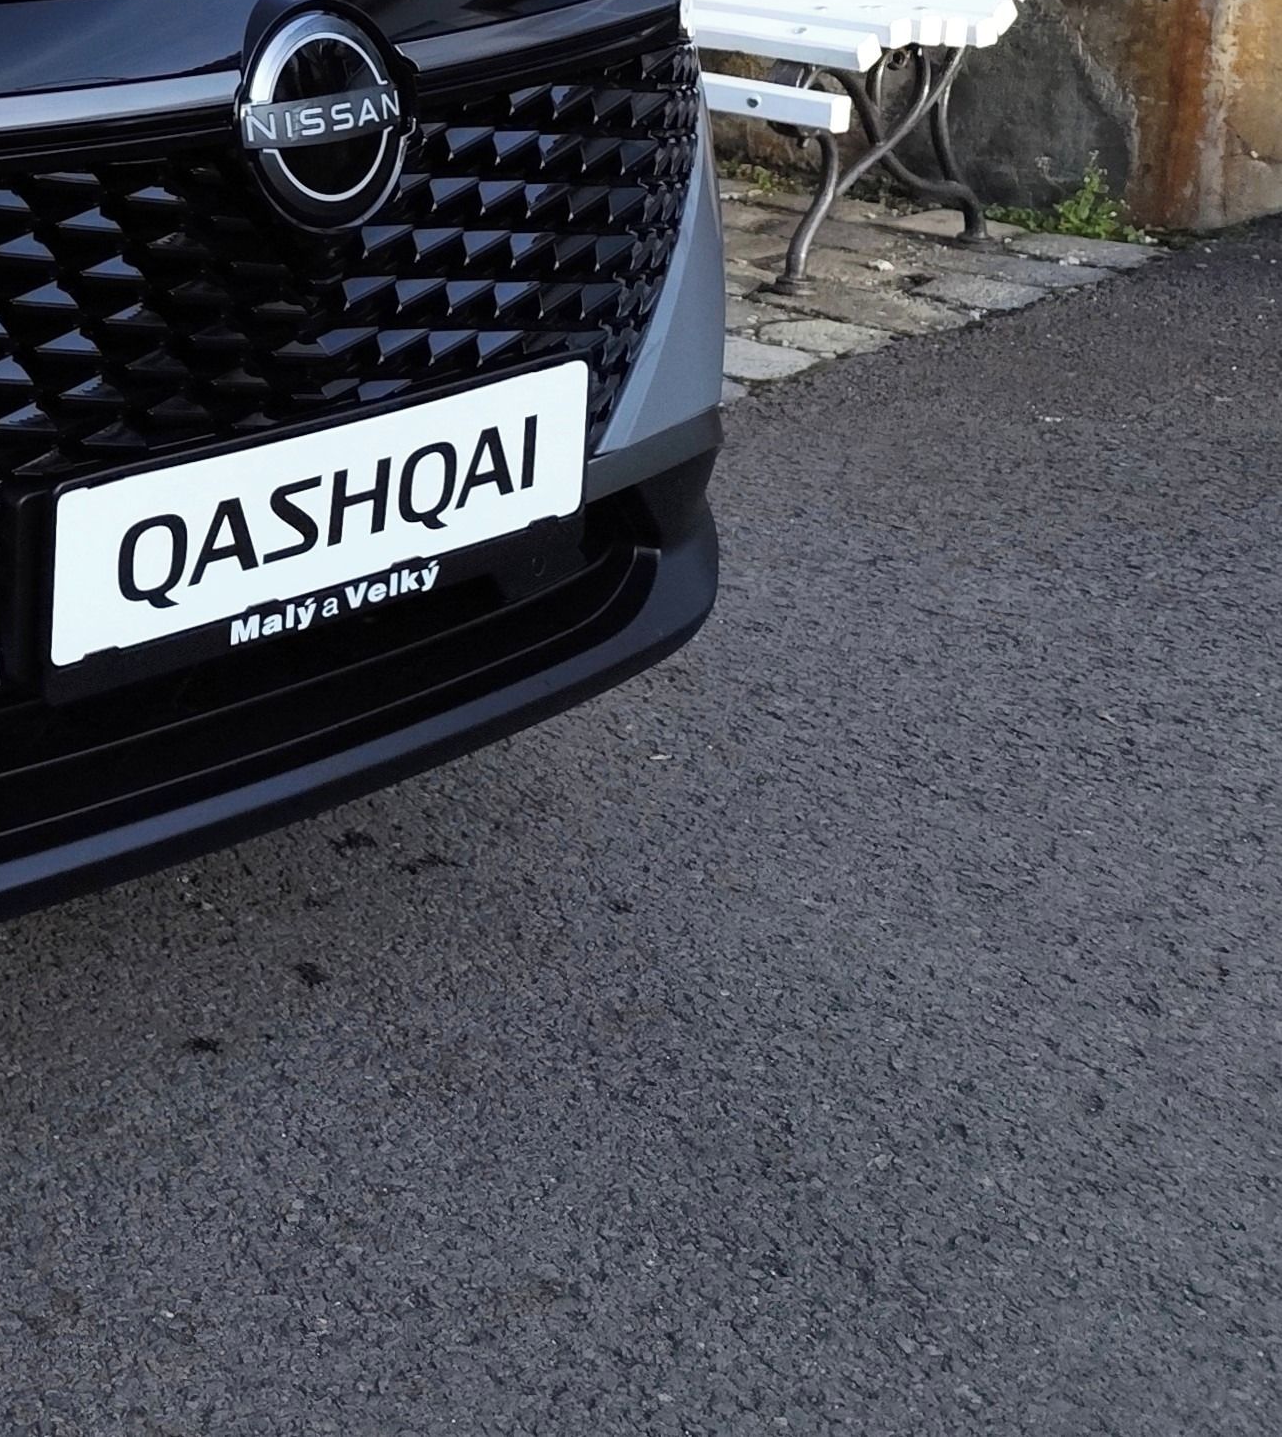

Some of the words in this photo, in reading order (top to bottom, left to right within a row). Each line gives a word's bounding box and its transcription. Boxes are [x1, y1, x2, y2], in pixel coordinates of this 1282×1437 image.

[244, 89, 401, 142] NISSAN
[117, 414, 538, 609] QASHQAI
[229, 595, 316, 646] Malý
[321, 594, 340, 619] a
[344, 559, 440, 611] Velký
